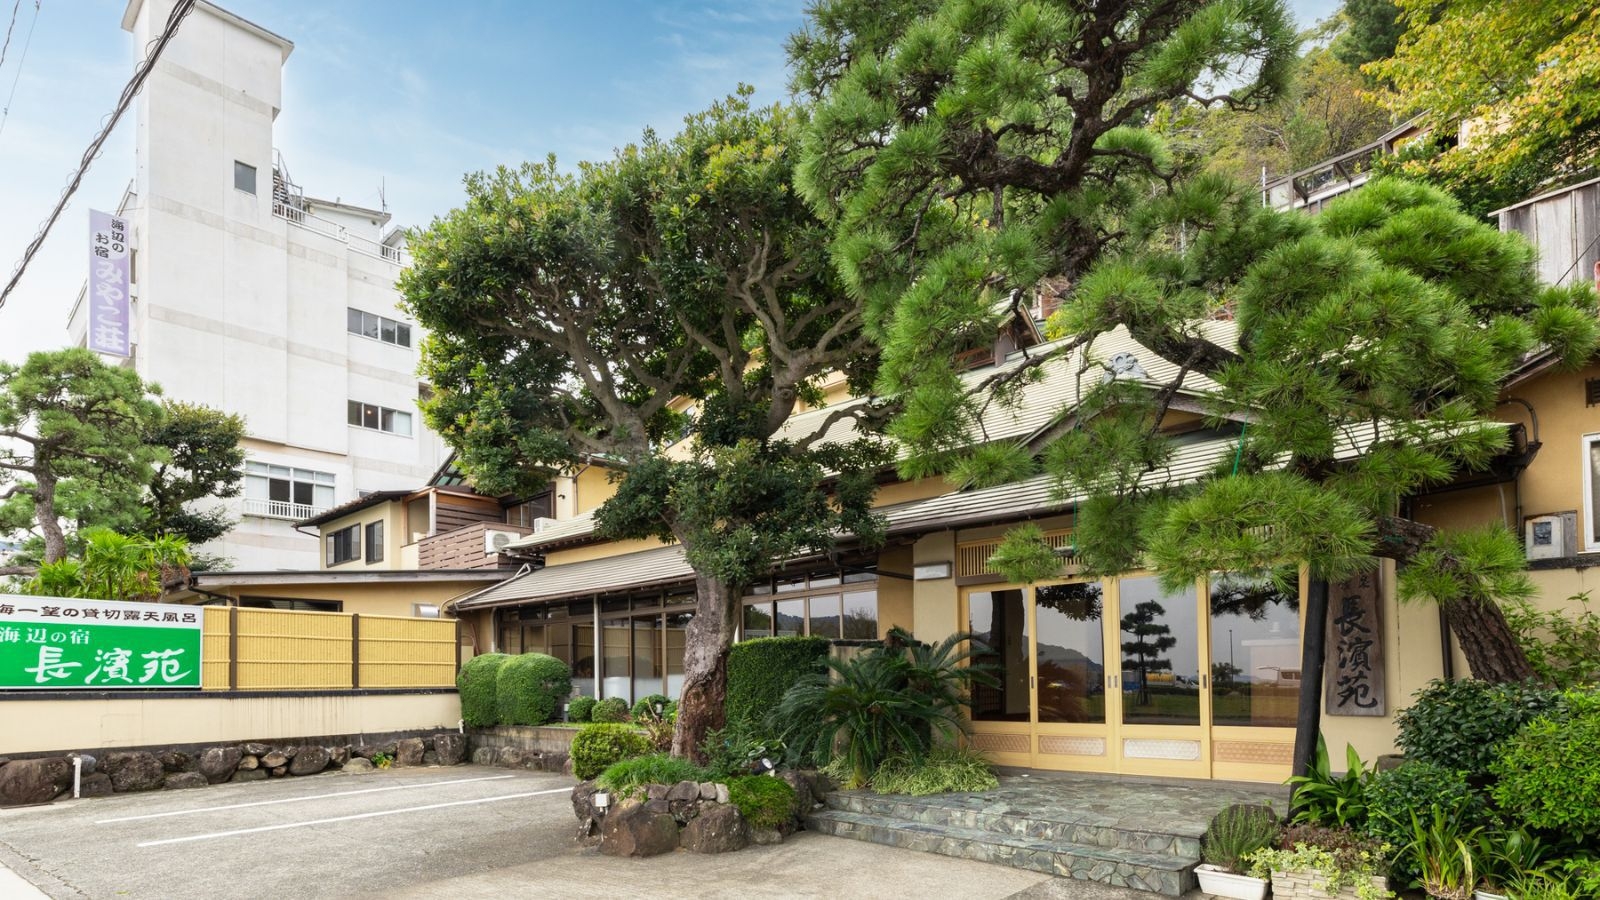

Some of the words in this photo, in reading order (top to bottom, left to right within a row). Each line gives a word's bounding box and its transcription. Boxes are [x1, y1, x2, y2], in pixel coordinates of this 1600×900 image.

[95, 232, 109, 259] お宿
[111, 218, 125, 253] 海辺の
[95, 260, 125, 351] みやこ荘
[0, 626, 90, 645] 海辺の宿
[1333, 594, 1378, 709] 長濱苑
[24, 645, 193, 684] 長濱苑
